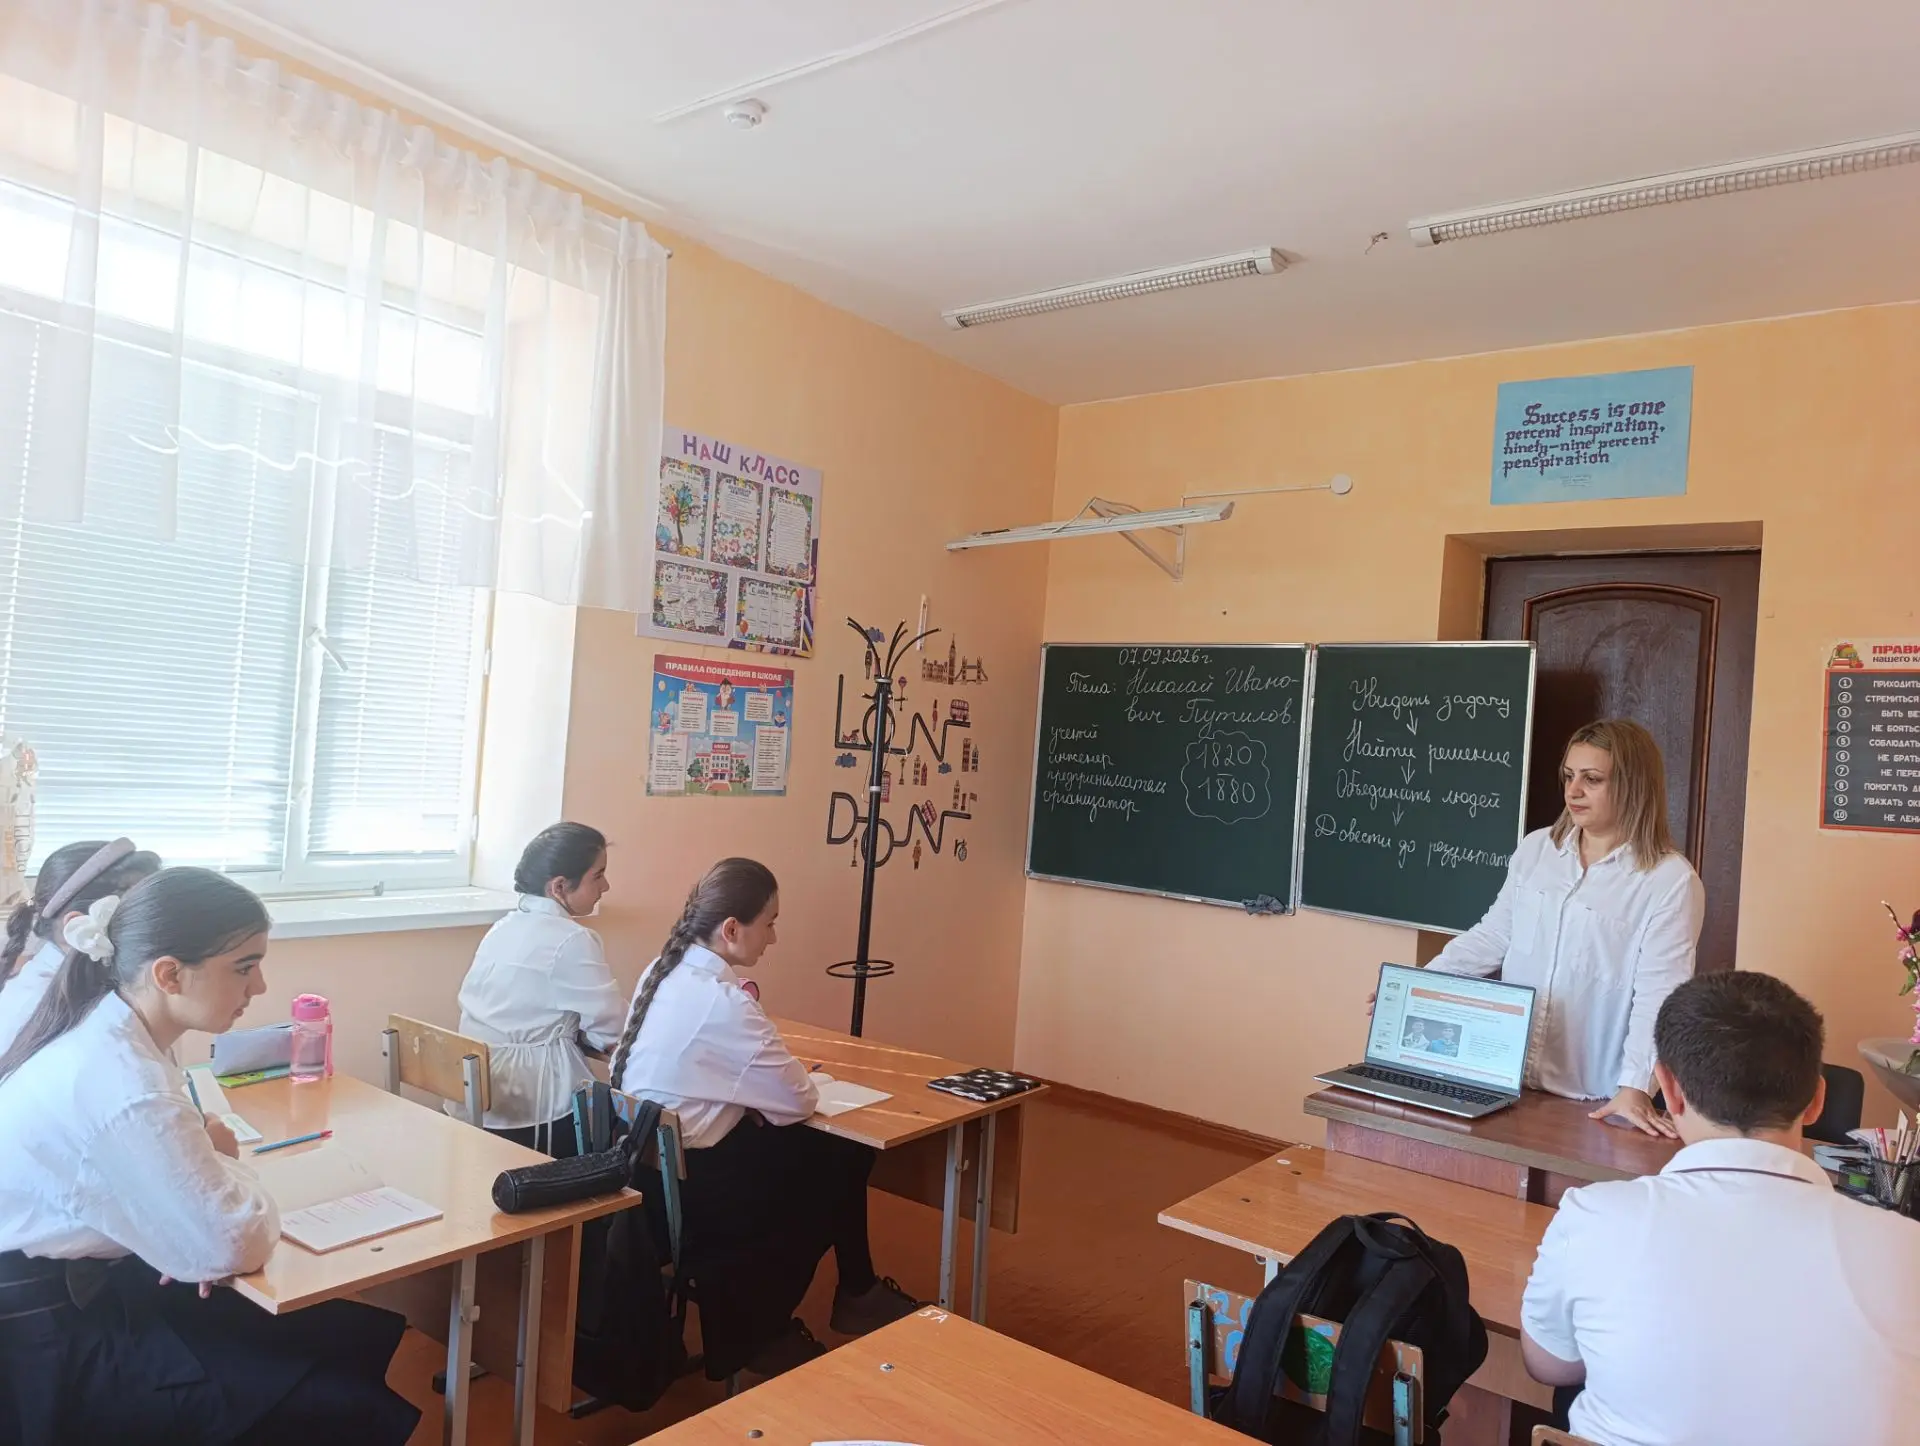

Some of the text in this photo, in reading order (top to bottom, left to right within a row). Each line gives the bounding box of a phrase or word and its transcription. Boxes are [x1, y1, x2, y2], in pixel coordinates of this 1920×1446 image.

[1522, 400, 1666, 426] Success is one
[1503, 431, 1660, 458] ninety-nine percent
[1505, 423, 1564, 446] percent
[682, 434, 731, 465] НАШ
[665, 662, 782, 681] ПРАВИЛА ПОВЕДЕНИЯ В ШКОЛЕ
[1066, 672, 1117, 694] Тема:
[1126, 668, 1214, 695] Николай
[1124, 696, 1165, 723] вич
[1349, 677, 1511, 721] Увидеть задачу
[1865, 695, 1920, 703] СТРЕМИТЬСЯ
[1881, 710, 1904, 718] БЫТЬ
[1871, 724, 1883, 732] НЕ
[1198, 742, 1252, 769] 1820
[1343, 718, 1511, 774] Найти решение
[1877, 754, 1890, 762] НЕ
[1048, 752, 1116, 770] инженер
[1047, 769, 1167, 794] предприниматель
[1198, 777, 1256, 804] 1880
[1863, 782, 1908, 792] ПОМОГАТЬ
[1043, 790, 1140, 823] организатор
[1442, 792, 1501, 817] людей
[1863, 797, 1903, 807] УВАЖАТЬ
[1883, 813, 1896, 822] НЕ
[1314, 813, 1391, 848] Довести
[1398, 839, 1416, 869] до
